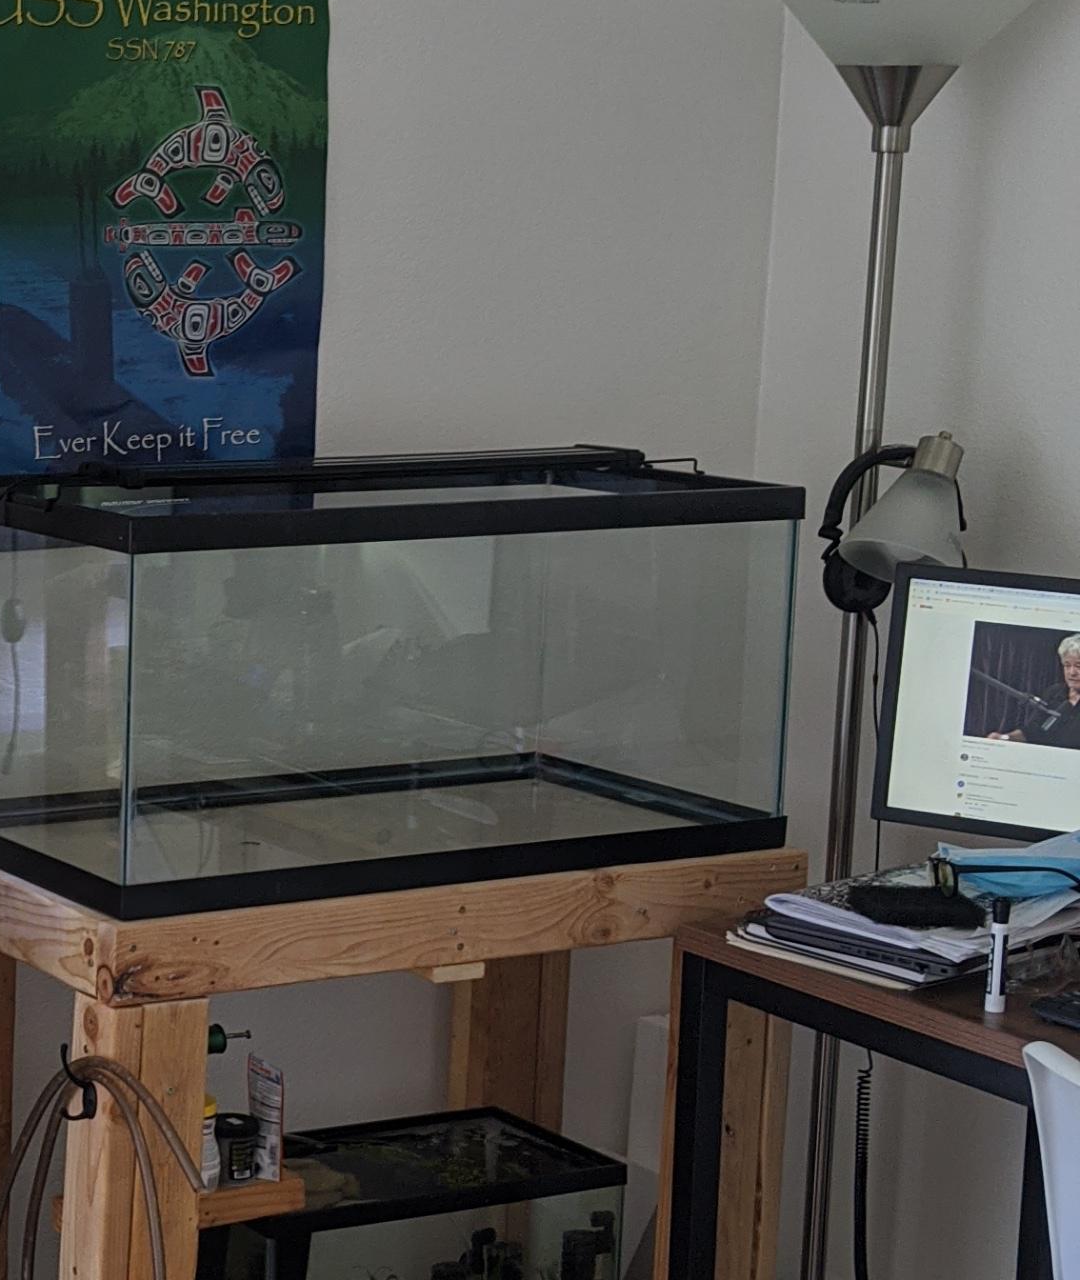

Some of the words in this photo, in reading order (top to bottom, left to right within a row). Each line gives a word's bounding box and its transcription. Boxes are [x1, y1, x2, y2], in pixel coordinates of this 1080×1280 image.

[105, 37, 159, 62] SSN
[165, 40, 197, 63] 787
[32, 424, 97, 460] Ever
[103, 420, 173, 462] Keep
[179, 424, 197, 448] it
[202, 416, 262, 452] Free
